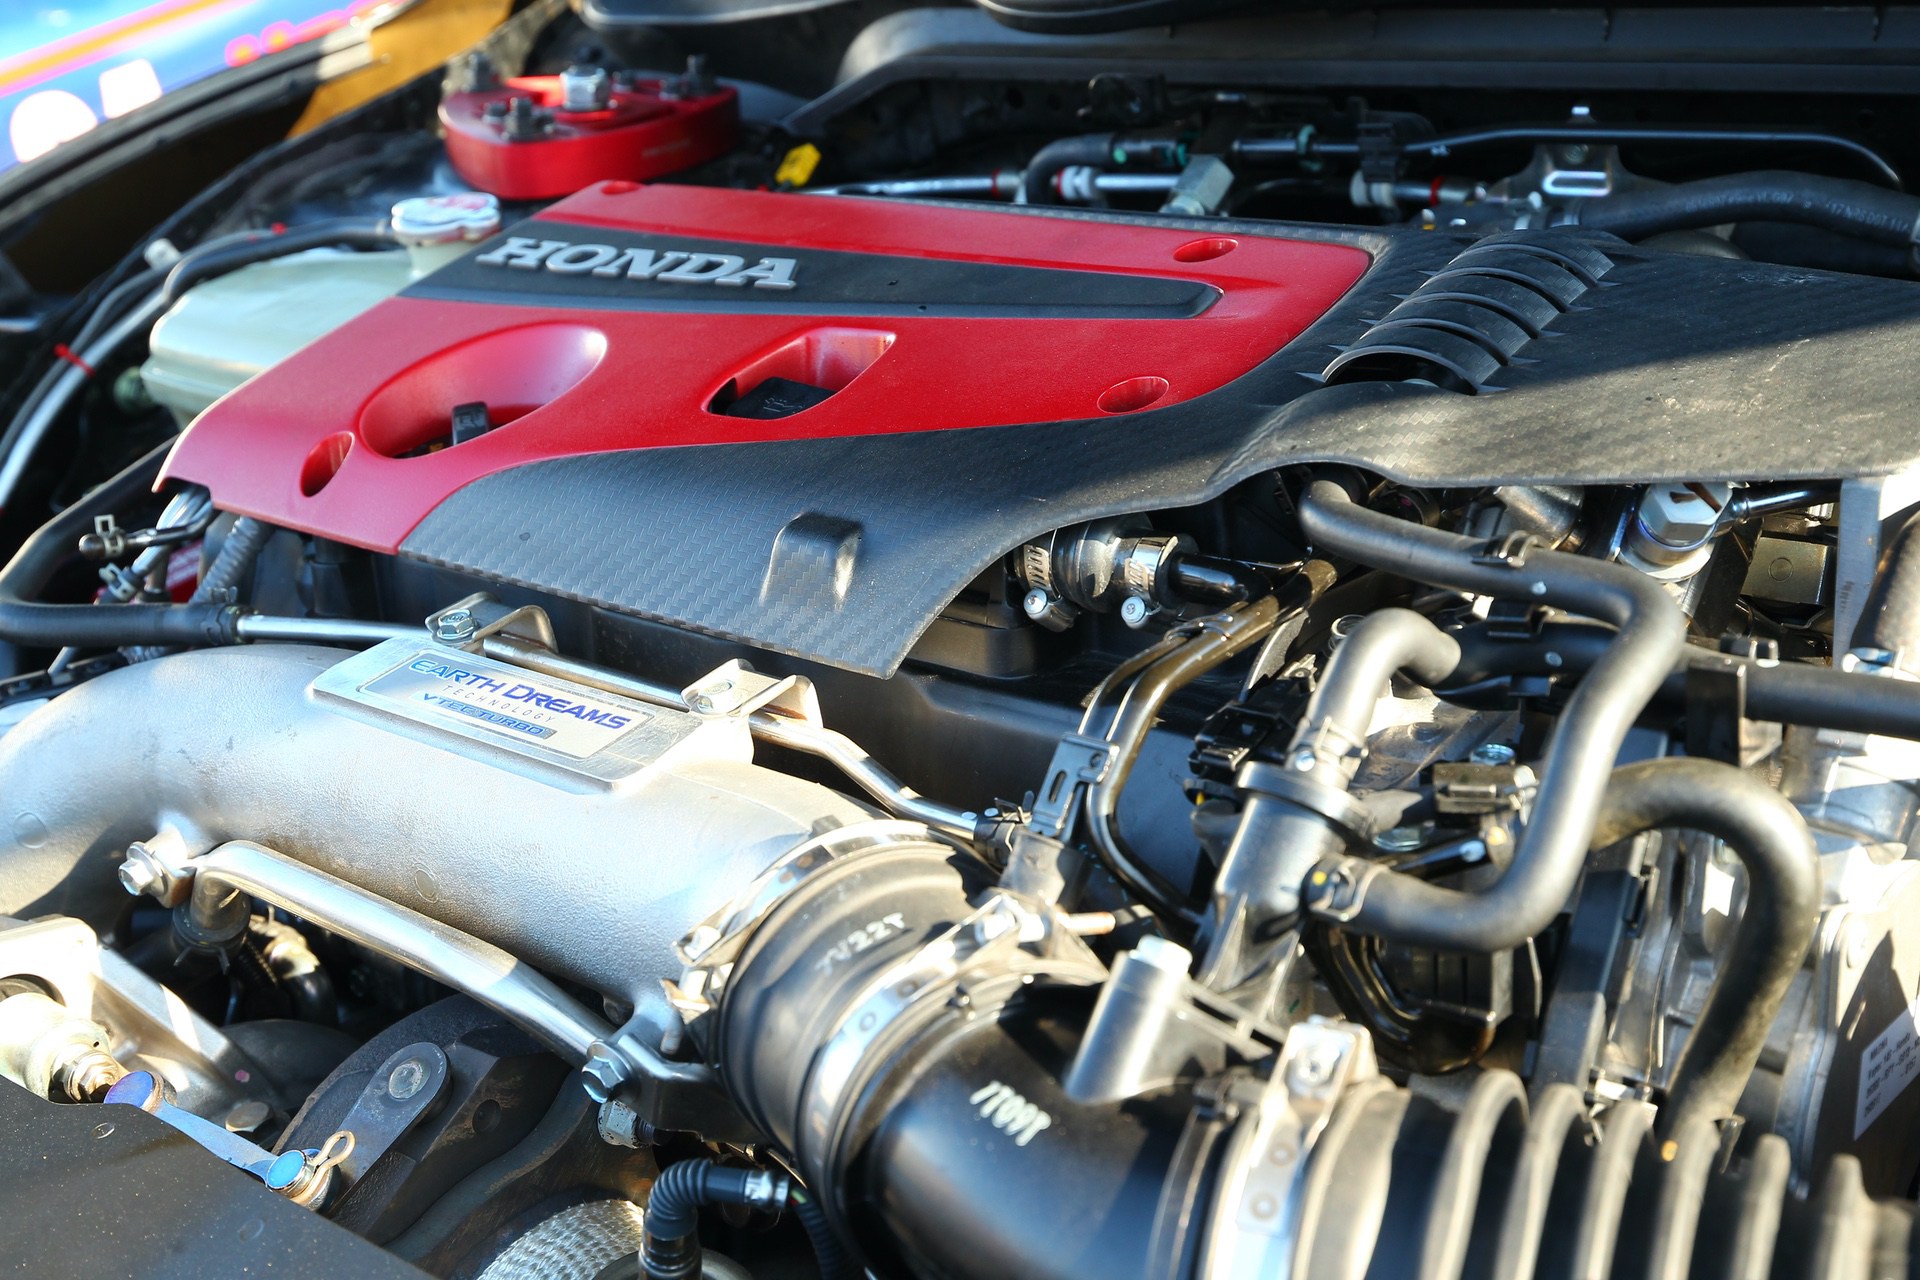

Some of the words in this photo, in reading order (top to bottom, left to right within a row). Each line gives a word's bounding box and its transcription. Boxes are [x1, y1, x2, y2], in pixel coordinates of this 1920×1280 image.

[475, 236, 797, 290] HONDA
[410, 659, 506, 693] EARTH
[502, 684, 632, 730] DREAMS
[424, 692, 477, 716] VTEC
[477, 710, 544, 736] TURBO
[442, 685, 558, 723] TECHNOLOGY
